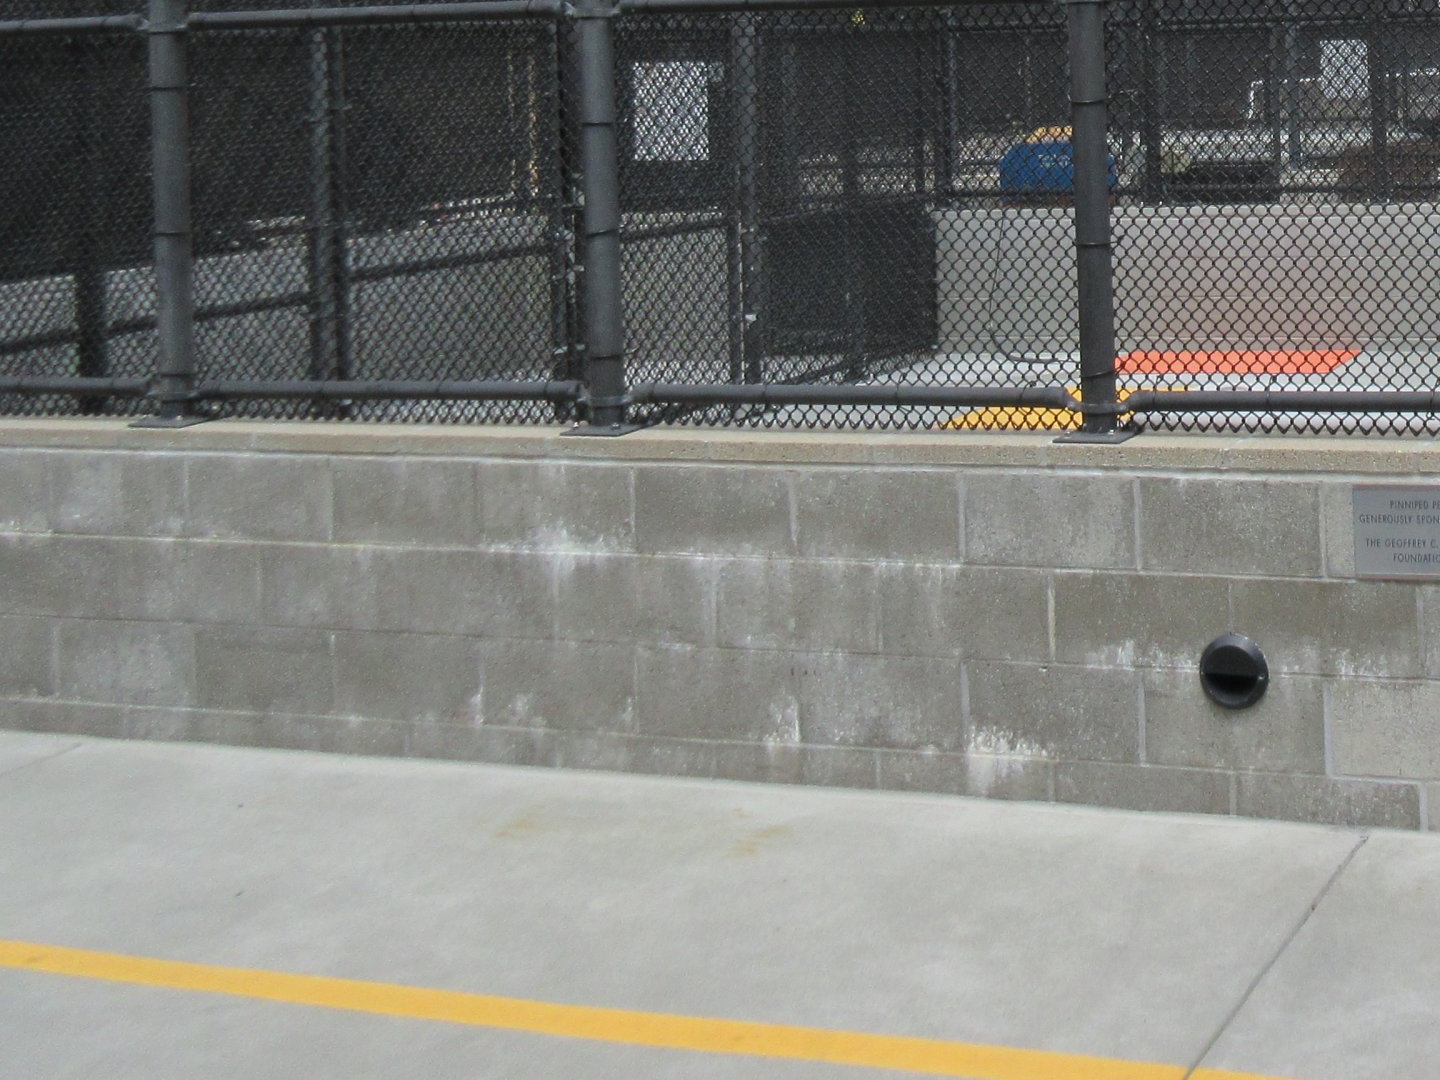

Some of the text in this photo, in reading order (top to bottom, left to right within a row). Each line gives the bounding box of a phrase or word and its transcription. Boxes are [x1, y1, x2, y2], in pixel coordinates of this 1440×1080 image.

[1390, 500, 1429, 510] PINNIPED
[1359, 514, 1413, 524] GENEROUSLY
[1366, 538, 1380, 548] THE
[1385, 538, 1426, 548] GEOFFREY
[1430, 539, 1438, 548] C.
